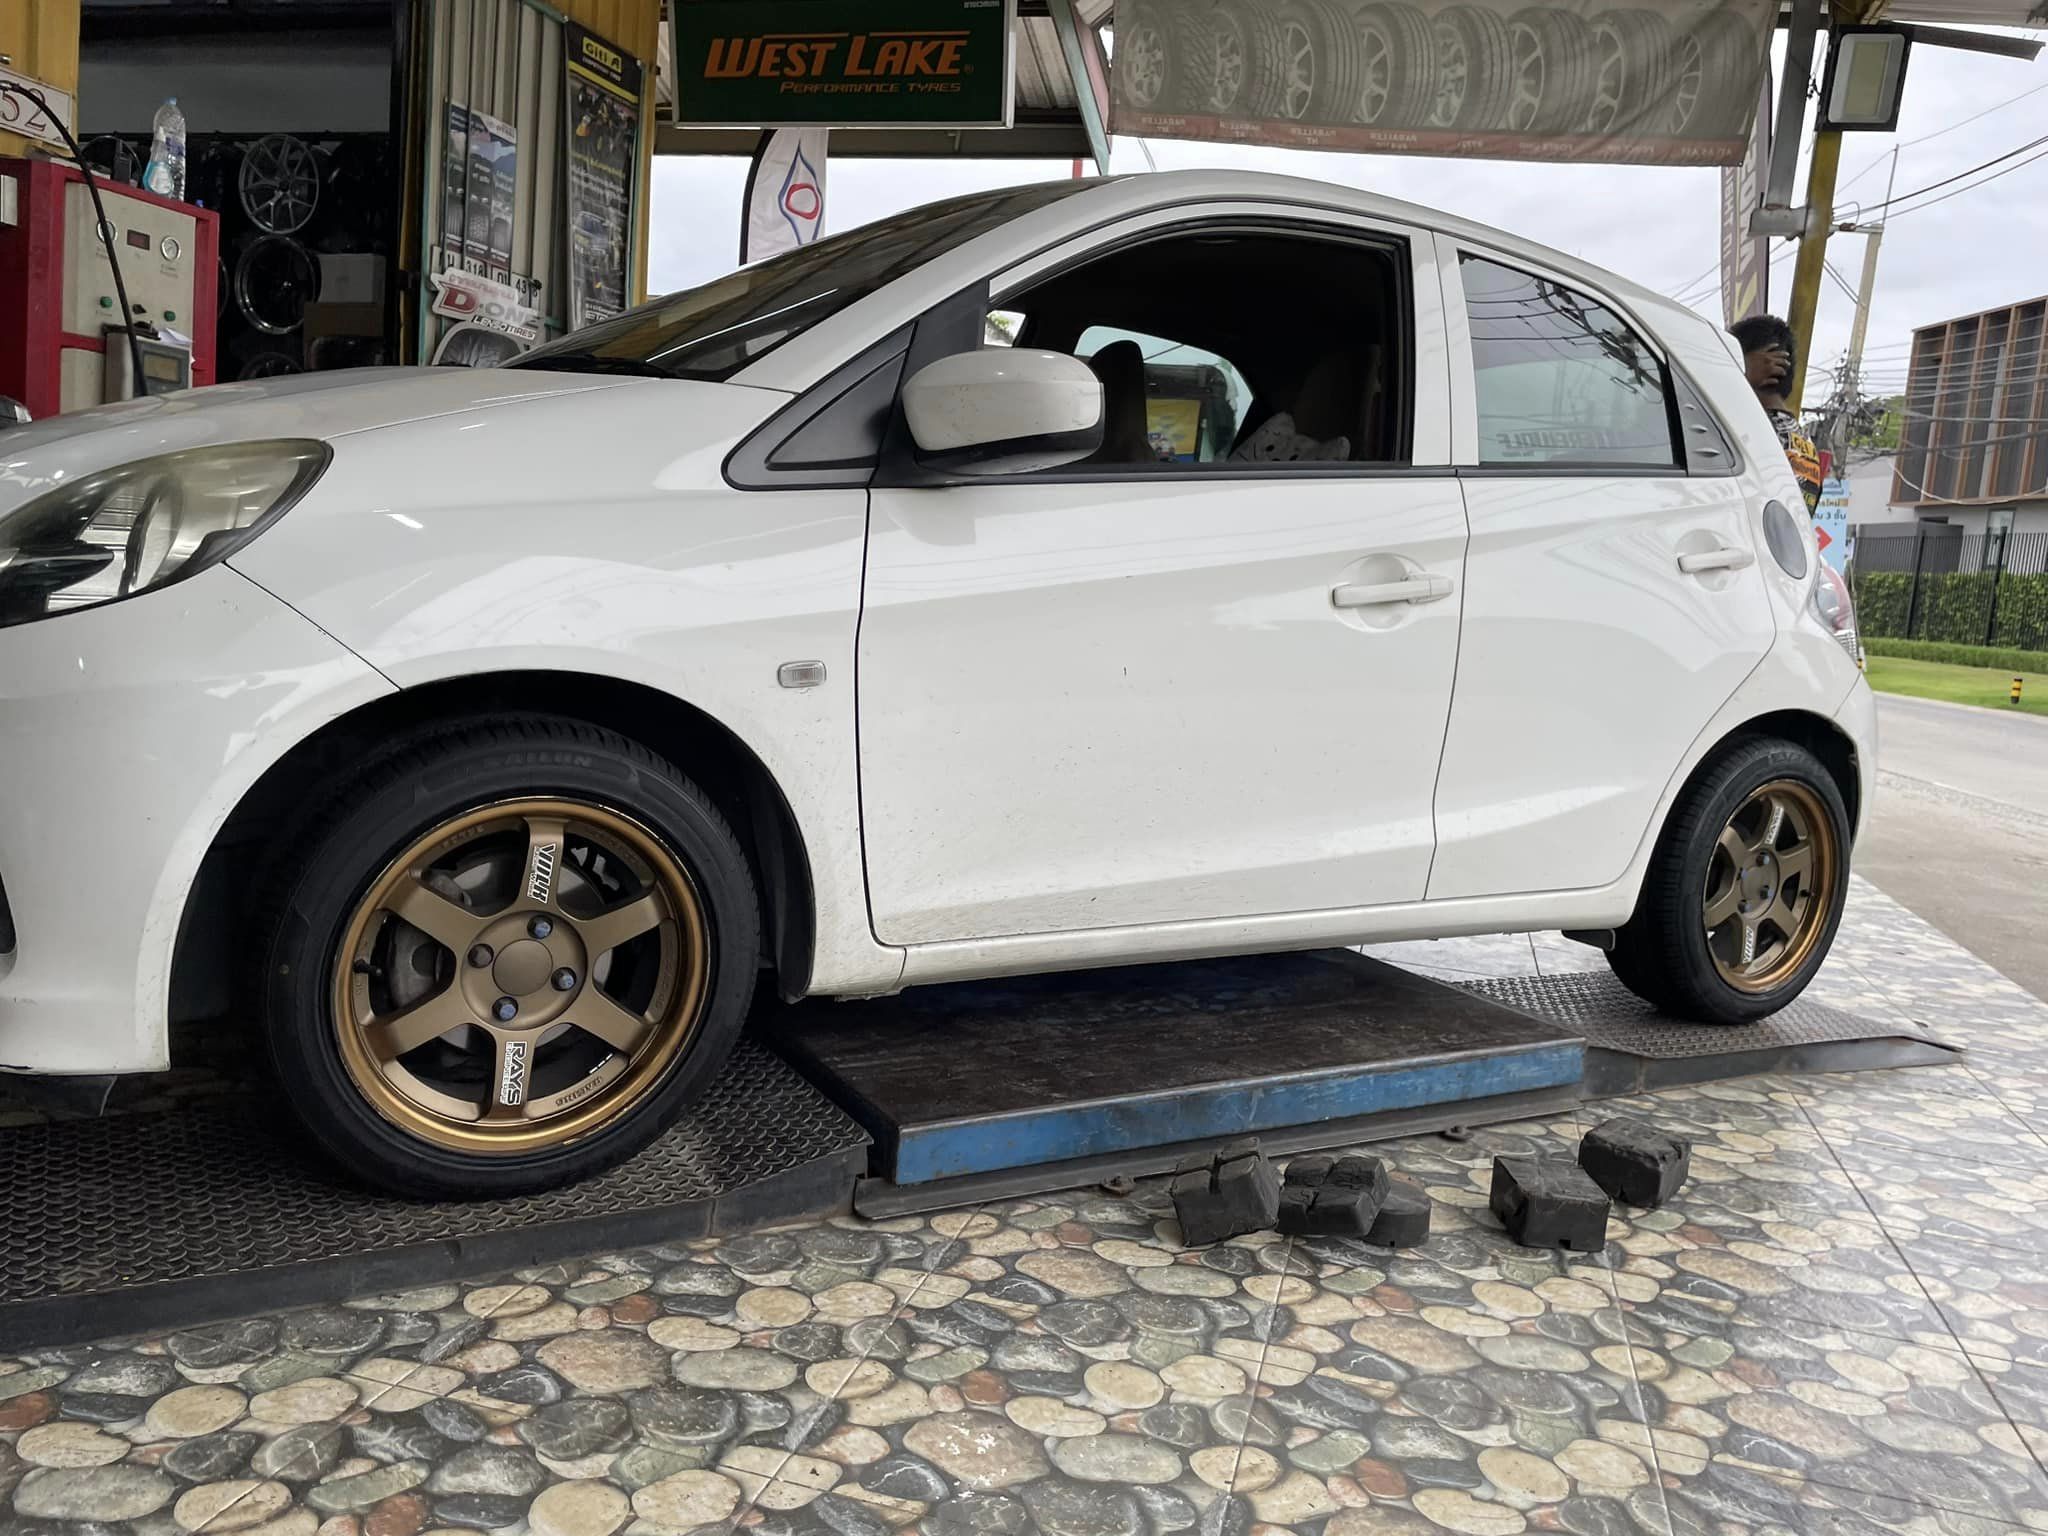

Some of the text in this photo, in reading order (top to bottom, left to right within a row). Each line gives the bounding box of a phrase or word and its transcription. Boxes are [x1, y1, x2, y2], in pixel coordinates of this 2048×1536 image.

[704, 34, 969, 78] WEST LAKE
[779, 81, 961, 94] PERFORMANCE TYRES
[507, 1041, 528, 1106] RAYS
